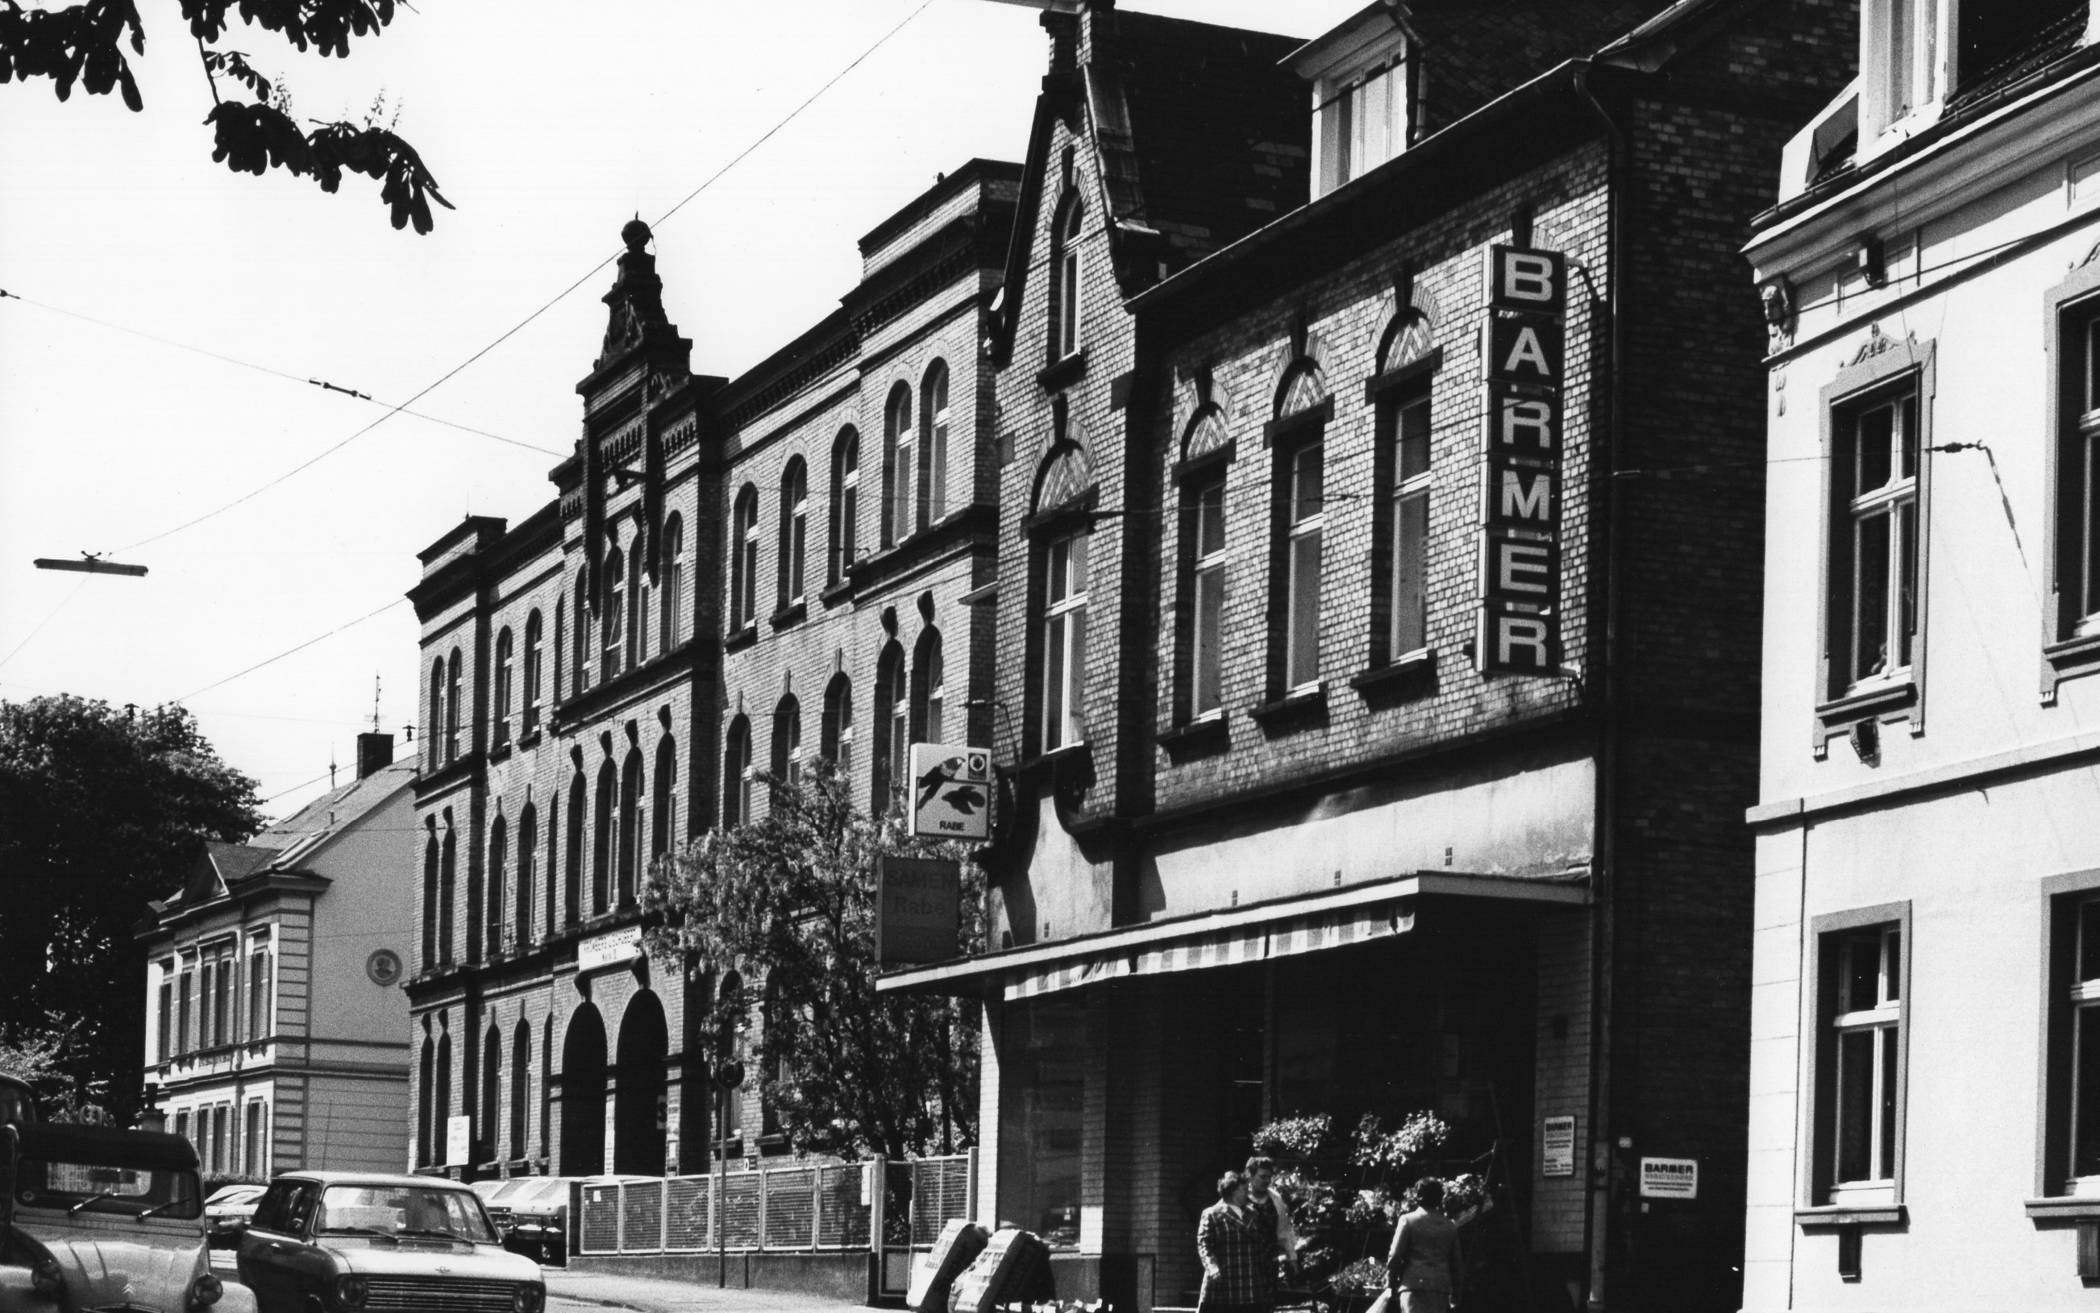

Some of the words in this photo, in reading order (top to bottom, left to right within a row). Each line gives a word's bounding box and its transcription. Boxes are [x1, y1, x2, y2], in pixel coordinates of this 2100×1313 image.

[1499, 252, 1553, 667] BARMER
[939, 820, 965, 831] RABE
[886, 870, 955, 889] SAMEN
[894, 895, 946, 915] Rabe
[1644, 1163, 1694, 1174] BARMER
